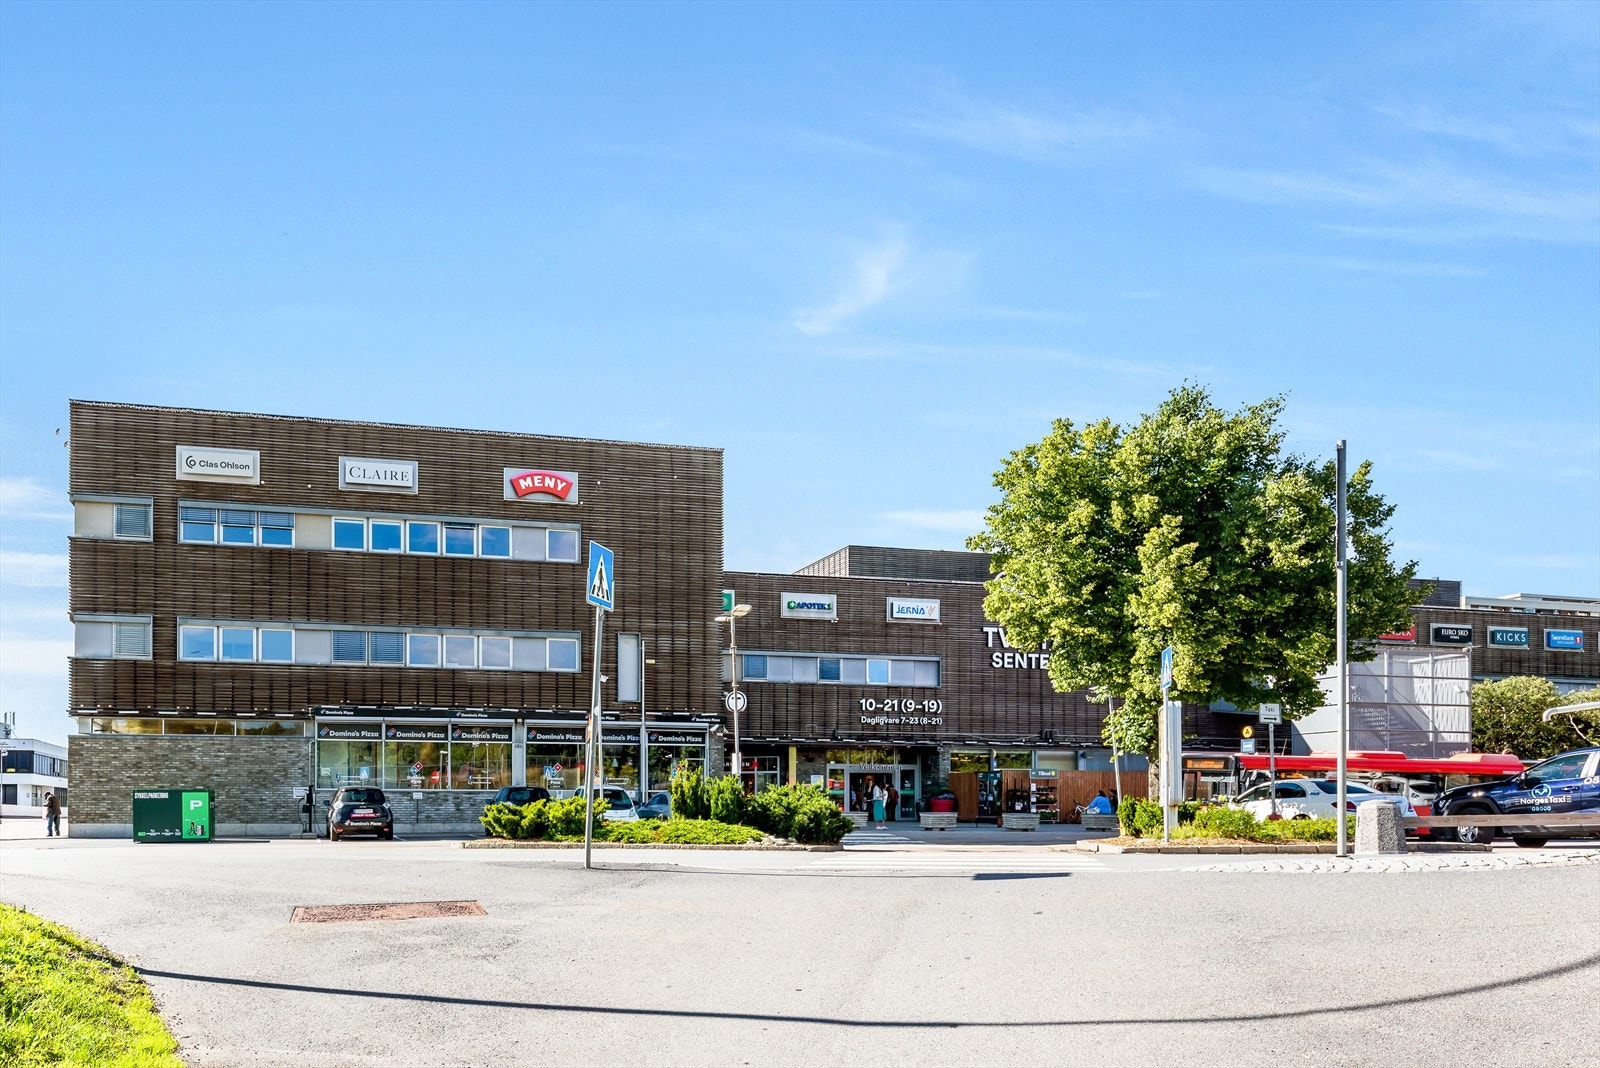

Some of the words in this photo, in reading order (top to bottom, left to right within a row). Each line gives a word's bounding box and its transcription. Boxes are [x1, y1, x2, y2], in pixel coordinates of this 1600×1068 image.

[198, 460, 218, 468] Clas
[220, 462, 250, 470] Ohlson
[349, 466, 410, 482] CLAIRE
[518, 476, 566, 491] MENY
[1496, 633, 1525, 642] KICKS
[992, 652, 1050, 670] SENTE
[861, 716, 900, 725] Dagligvare
[190, 800, 202, 810] P
